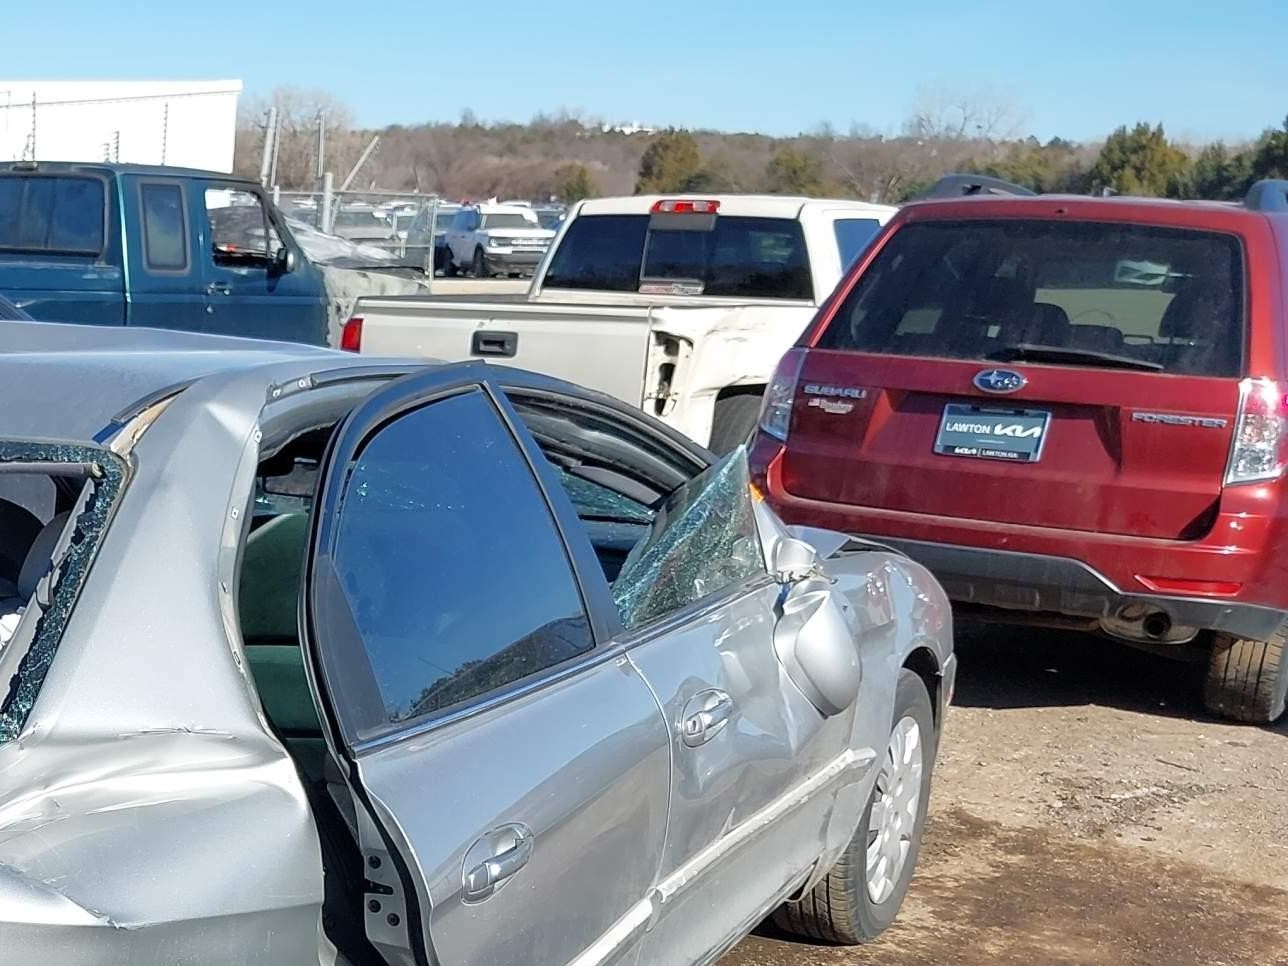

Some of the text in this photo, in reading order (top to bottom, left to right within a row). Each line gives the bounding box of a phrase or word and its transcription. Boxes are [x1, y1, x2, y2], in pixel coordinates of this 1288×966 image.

[804, 384, 867, 399] SUBARU
[945, 422, 991, 434] LAWTON
[1132, 411, 1228, 430] FORESTER
